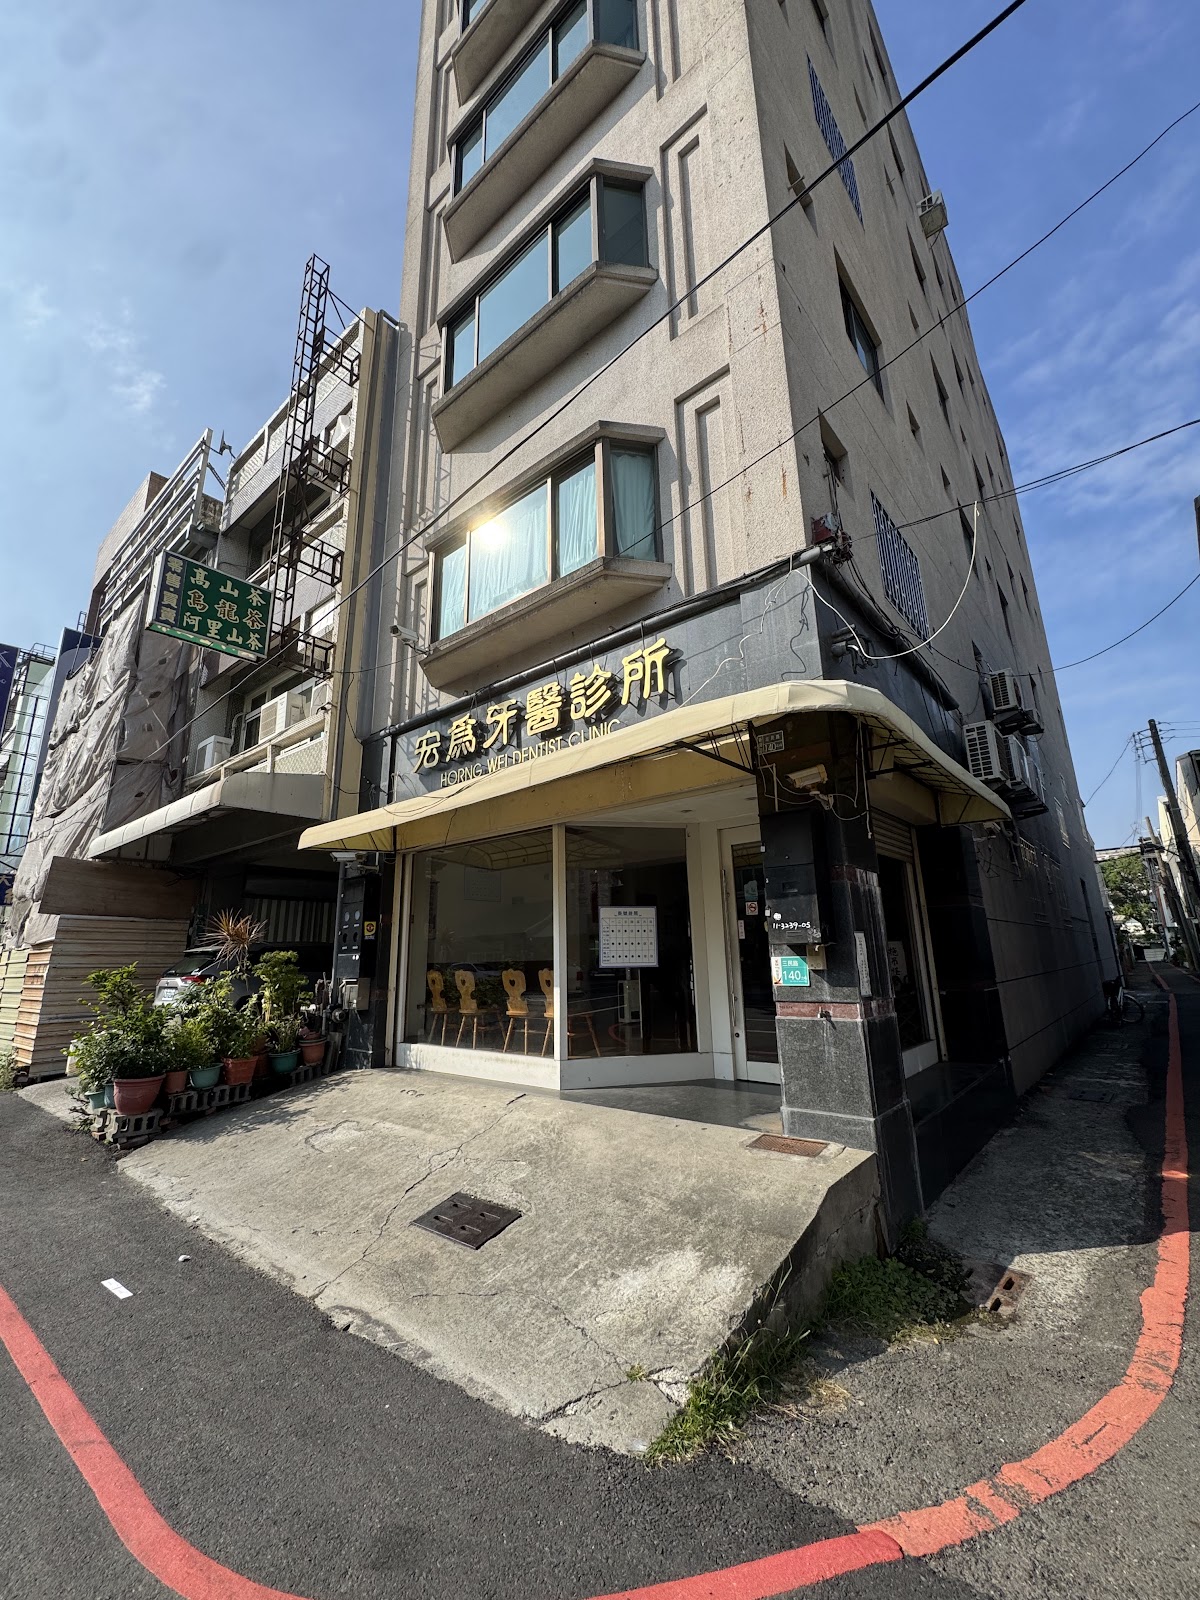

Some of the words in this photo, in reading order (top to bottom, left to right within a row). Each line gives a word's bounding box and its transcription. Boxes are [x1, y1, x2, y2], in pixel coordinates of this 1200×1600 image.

[187, 589, 266, 630] 烏龍茶
[183, 611, 264, 651] 阿里山茶
[440, 763, 483, 788] HORNG
[487, 754, 508, 774] WEI
[512, 736, 563, 764] DENTIST
[568, 719, 621, 747] CLINIC
